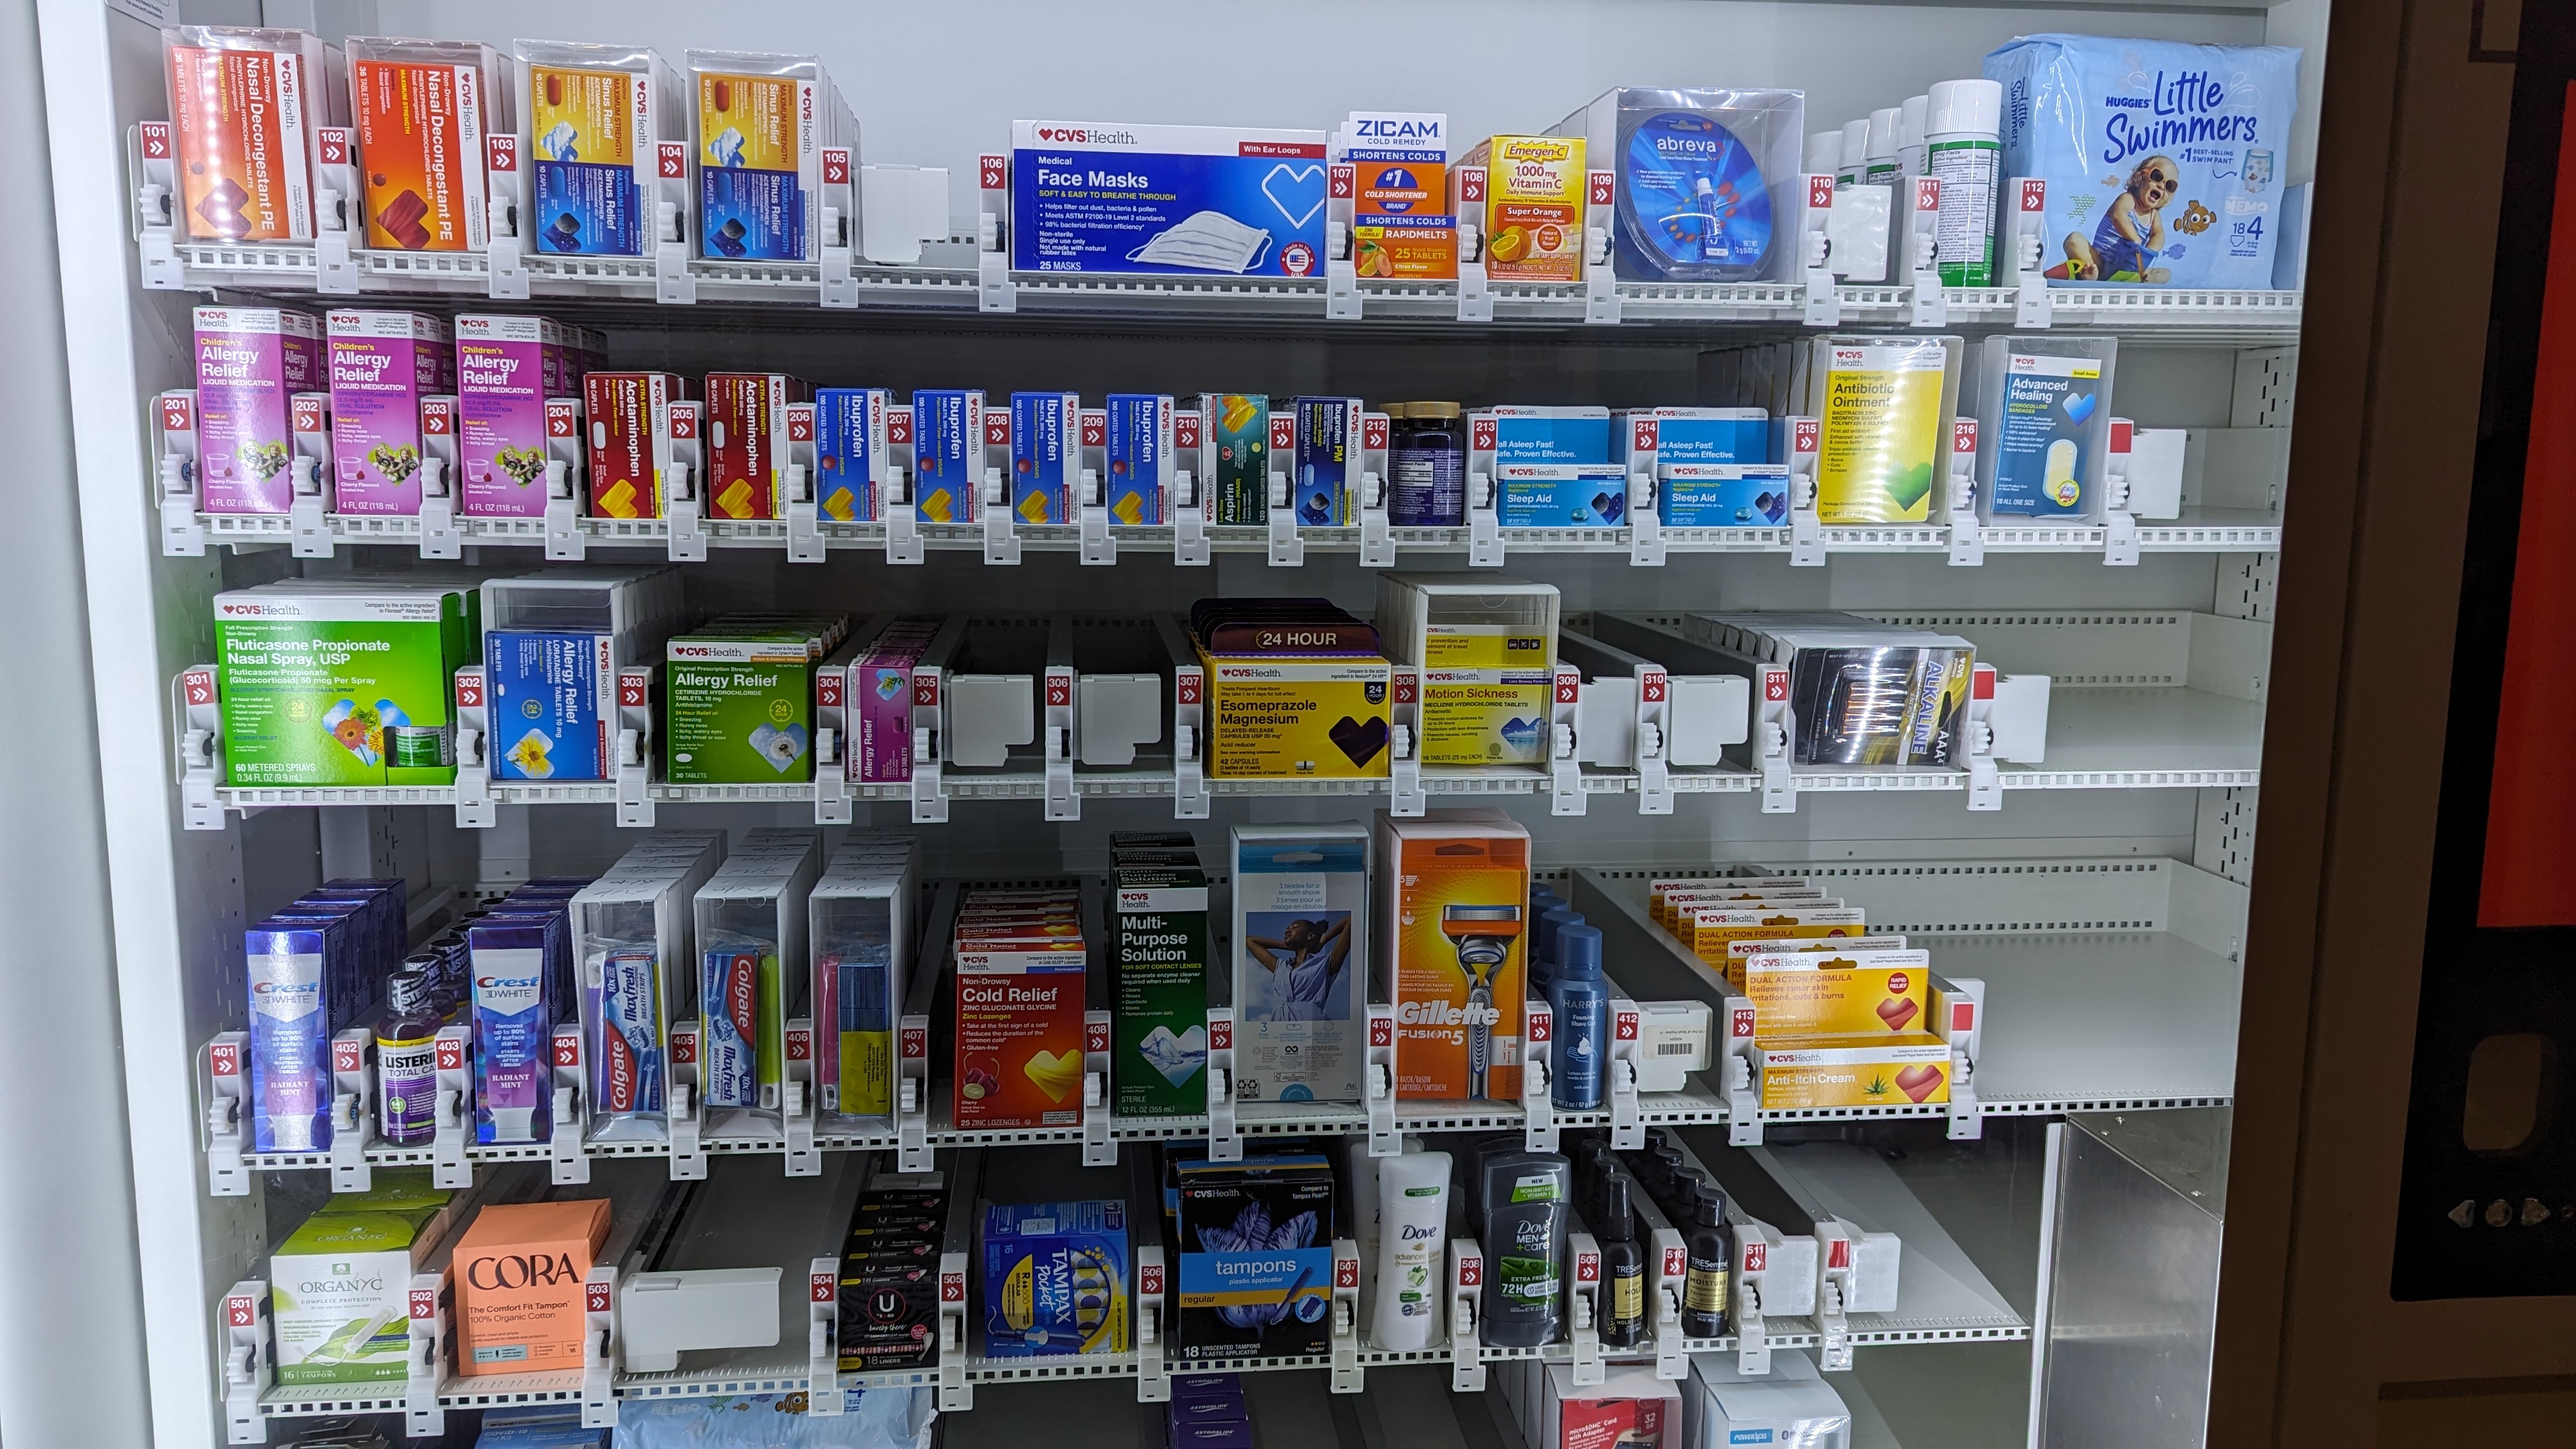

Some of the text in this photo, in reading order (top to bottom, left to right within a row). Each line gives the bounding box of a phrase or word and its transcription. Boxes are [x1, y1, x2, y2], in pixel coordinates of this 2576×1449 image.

[2106, 71, 2223, 115] HUGGIES Little
[144, 126, 166, 138] 101
[1357, 120, 1440, 138] ZICAM
[321, 132, 343, 143] 102
[2104, 112, 2256, 164] Swimmers
[1244, 145, 1261, 153] With
[1657, 136, 1716, 153] abreva
[427, 71, 452, 241] Nasal Decongestant PE
[661, 148, 681, 158] 104
[1353, 151, 1440, 161] SHORTENS COLDS
[982, 158, 1002, 169] 106
[1038, 157, 1071, 165] Medical
[1038, 170, 1148, 188] Face Masks
[1332, 169, 1351, 179] 107
[1464, 172, 1483, 182] 108
[1546, 170, 1556, 180] mg
[1509, 178, 1562, 188] Vitamin C
[1813, 179, 1831, 188] 110
[2025, 182, 2043, 192] 112
[1386, 231, 1448, 239] RAPIDMELTS
[1039, 261, 1081, 270] 25 MASKS
[333, 342, 374, 352] Children's
[334, 353, 391, 369] Allergy
[335, 367, 379, 381] Relief
[1834, 383, 1894, 394] Antibiotic
[2012, 378, 2068, 391] Advanced
[2011, 389, 2052, 402] Healing
[165, 399, 186, 410] 201
[295, 401, 318, 412] 202
[1833, 396, 1890, 408] Ointment
[549, 408, 571, 417] 204
[789, 413, 809, 422] 206
[987, 416, 1008, 425] 208
[1178, 420, 1197, 429] 210
[626, 379, 640, 477] Acetaminophen
[852, 395, 861, 458] Ibuprofen
[1367, 421, 1386, 431] 212
[1476, 422, 1495, 432] 213
[1798, 425, 1814, 434] 215
[1957, 425, 1975, 434] 216
[1334, 446, 1342, 462] PM
[1225, 483, 1234, 523] Aspirin
[1507, 494, 1533, 504] Sleep
[1263, 632, 1336, 646] 24 HOUR
[226, 639, 390, 653] Fluticasone Propionate
[227, 652, 351, 667] Nasal Spray, USP
[187, 675, 208, 686] 301
[459, 678, 480, 688] 302
[622, 678, 643, 688] 303
[675, 673, 778, 688] Allergy Relief
[916, 678, 935, 687] 305
[1180, 677, 1199, 686] 307
[1397, 677, 1414, 686] 308
[1559, 677, 1576, 686] 309
[1768, 675, 1786, 684] 311
[1425, 688, 1518, 698] Motion Sickness
[1220, 700, 1317, 713] Esomeprazole
[1910, 661, 1942, 755] ALKALINE
[1220, 713, 1299, 726] Magnesium
[236, 763, 316, 772] 60 METERED SPRAYS
[1122, 916, 1167, 930] Multi-
[1122, 933, 1187, 948] Purpose
[1121, 948, 1186, 962] Solution
[477, 976, 540, 988] Crest
[962, 978, 1011, 986] Non-Drowsy
[962, 988, 1057, 1001] Cold Relief
[1563, 998, 1604, 1008] HARRY'S
[1398, 1000, 1499, 1025] Gillette
[1620, 1015, 1637, 1024] 412
[1088, 1026, 1107, 1035] 408
[1372, 1021, 1391, 1030] 410
[788, 1034, 808, 1043] 406
[438, 1041, 459, 1052] 403
[555, 1040, 576, 1049] 404
[213, 1048, 234, 1057] 401
[612, 1041, 627, 1109] Colgate
[1767, 1073, 1855, 1085] Anti-Itch Cream
[1402, 1225, 1437, 1239] Dove
[1517, 1220, 1549, 1234] Dove
[1666, 1249, 1684, 1259] 510
[1216, 1259, 1296, 1275] tampons
[1462, 1260, 1480, 1269] 508
[468, 1253, 581, 1291] CORA
[1144, 1268, 1162, 1277] 506
[813, 1276, 833, 1285] 504
[1052, 1248, 1072, 1324] TAMPAX
[1502, 1284, 1522, 1294] 72H
[411, 1292, 432, 1302] 502
[1184, 1296, 1215, 1304] regular
[231, 1300, 250, 1310] 501
[489, 1303, 520, 1313] Comfort
[534, 1301, 567, 1310] Tampon
[470, 1315, 491, 1324] 100%
[493, 1313, 526, 1323] Organic
[866, 1356, 877, 1365] 18
